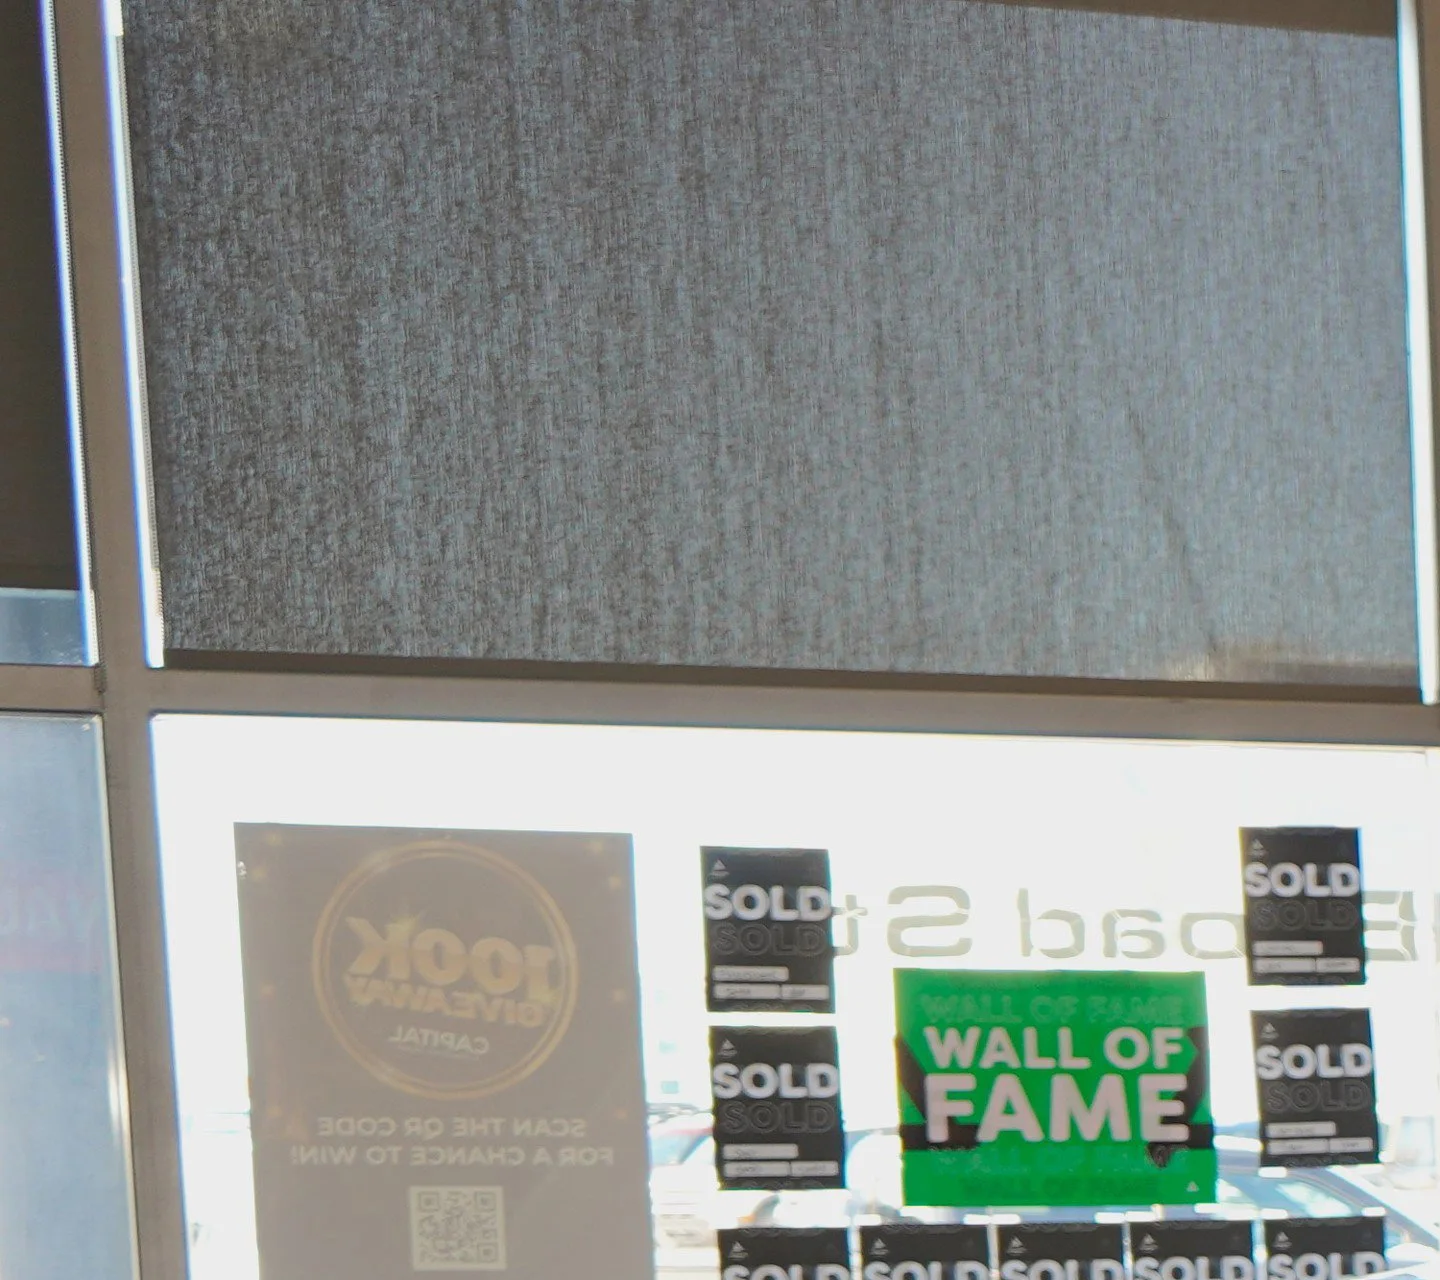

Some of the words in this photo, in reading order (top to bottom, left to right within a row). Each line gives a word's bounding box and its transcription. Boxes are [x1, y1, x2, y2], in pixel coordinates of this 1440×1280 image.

[1244, 861, 1360, 898] SOLD
[703, 883, 832, 921] SOLD
[923, 1026, 1092, 1070] WALL
[1103, 1027, 1185, 1070] OF
[1256, 1043, 1373, 1080] SOLD
[712, 1062, 839, 1099] SOLD
[923, 1073, 1191, 1143] FAME
